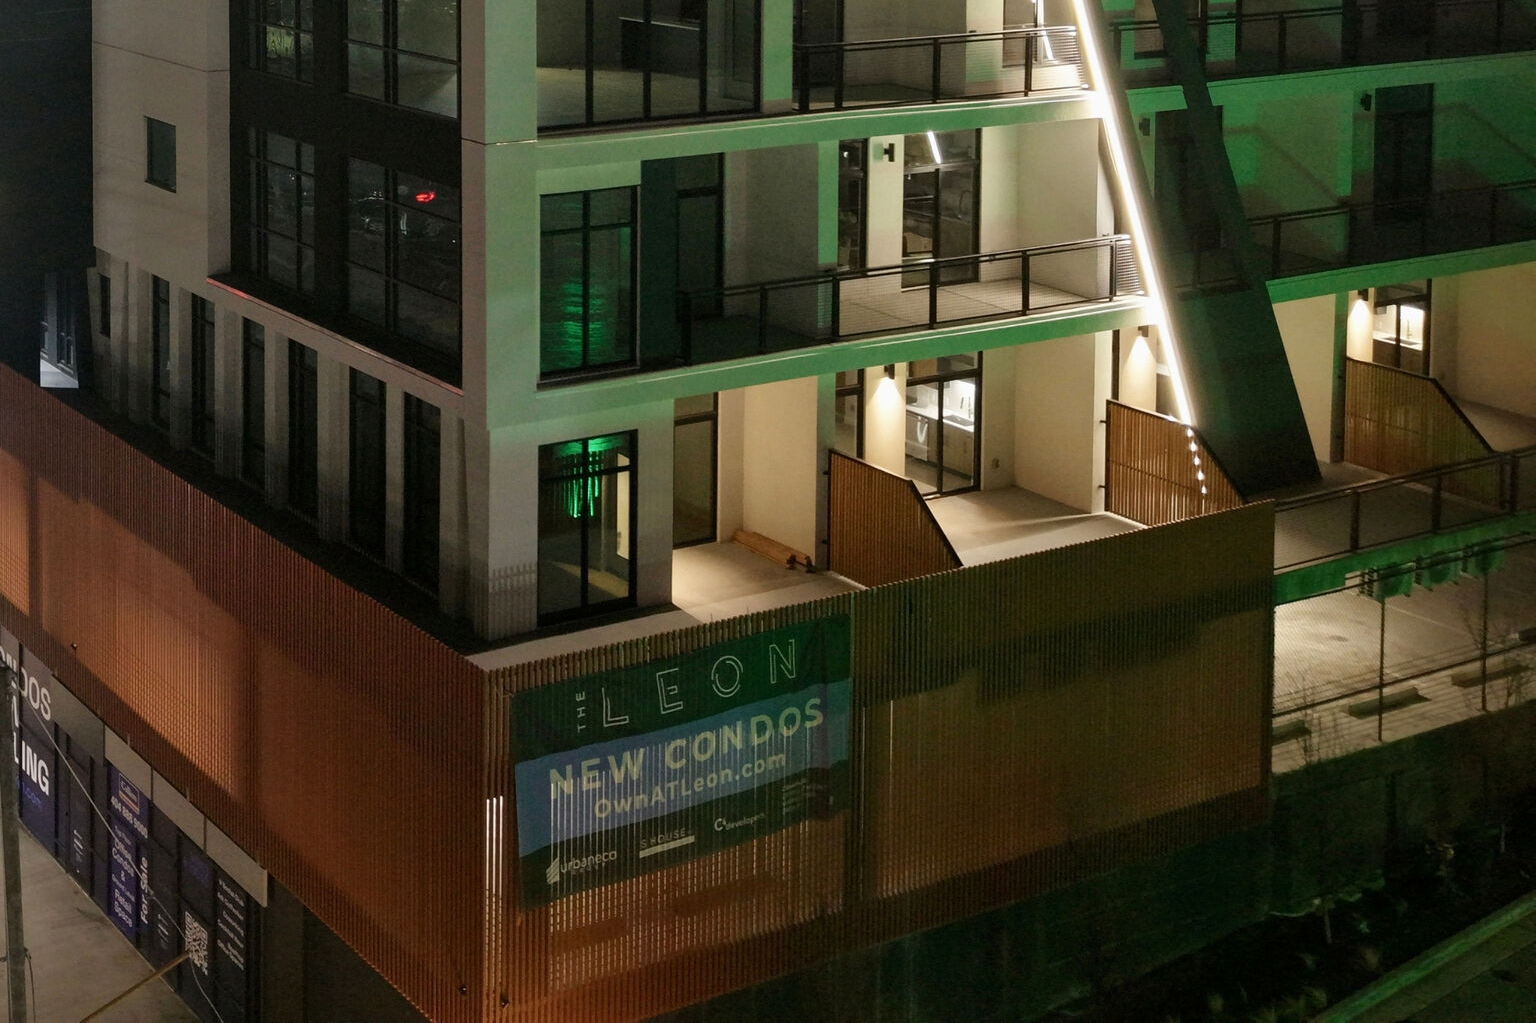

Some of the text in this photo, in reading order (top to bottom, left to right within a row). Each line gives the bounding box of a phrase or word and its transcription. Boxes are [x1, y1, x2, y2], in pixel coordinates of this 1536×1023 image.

[575, 639, 797, 734] THE LEON
[549, 697, 824, 799] NEW CONDOS
[594, 753, 786, 818] OwnATLeon.com
